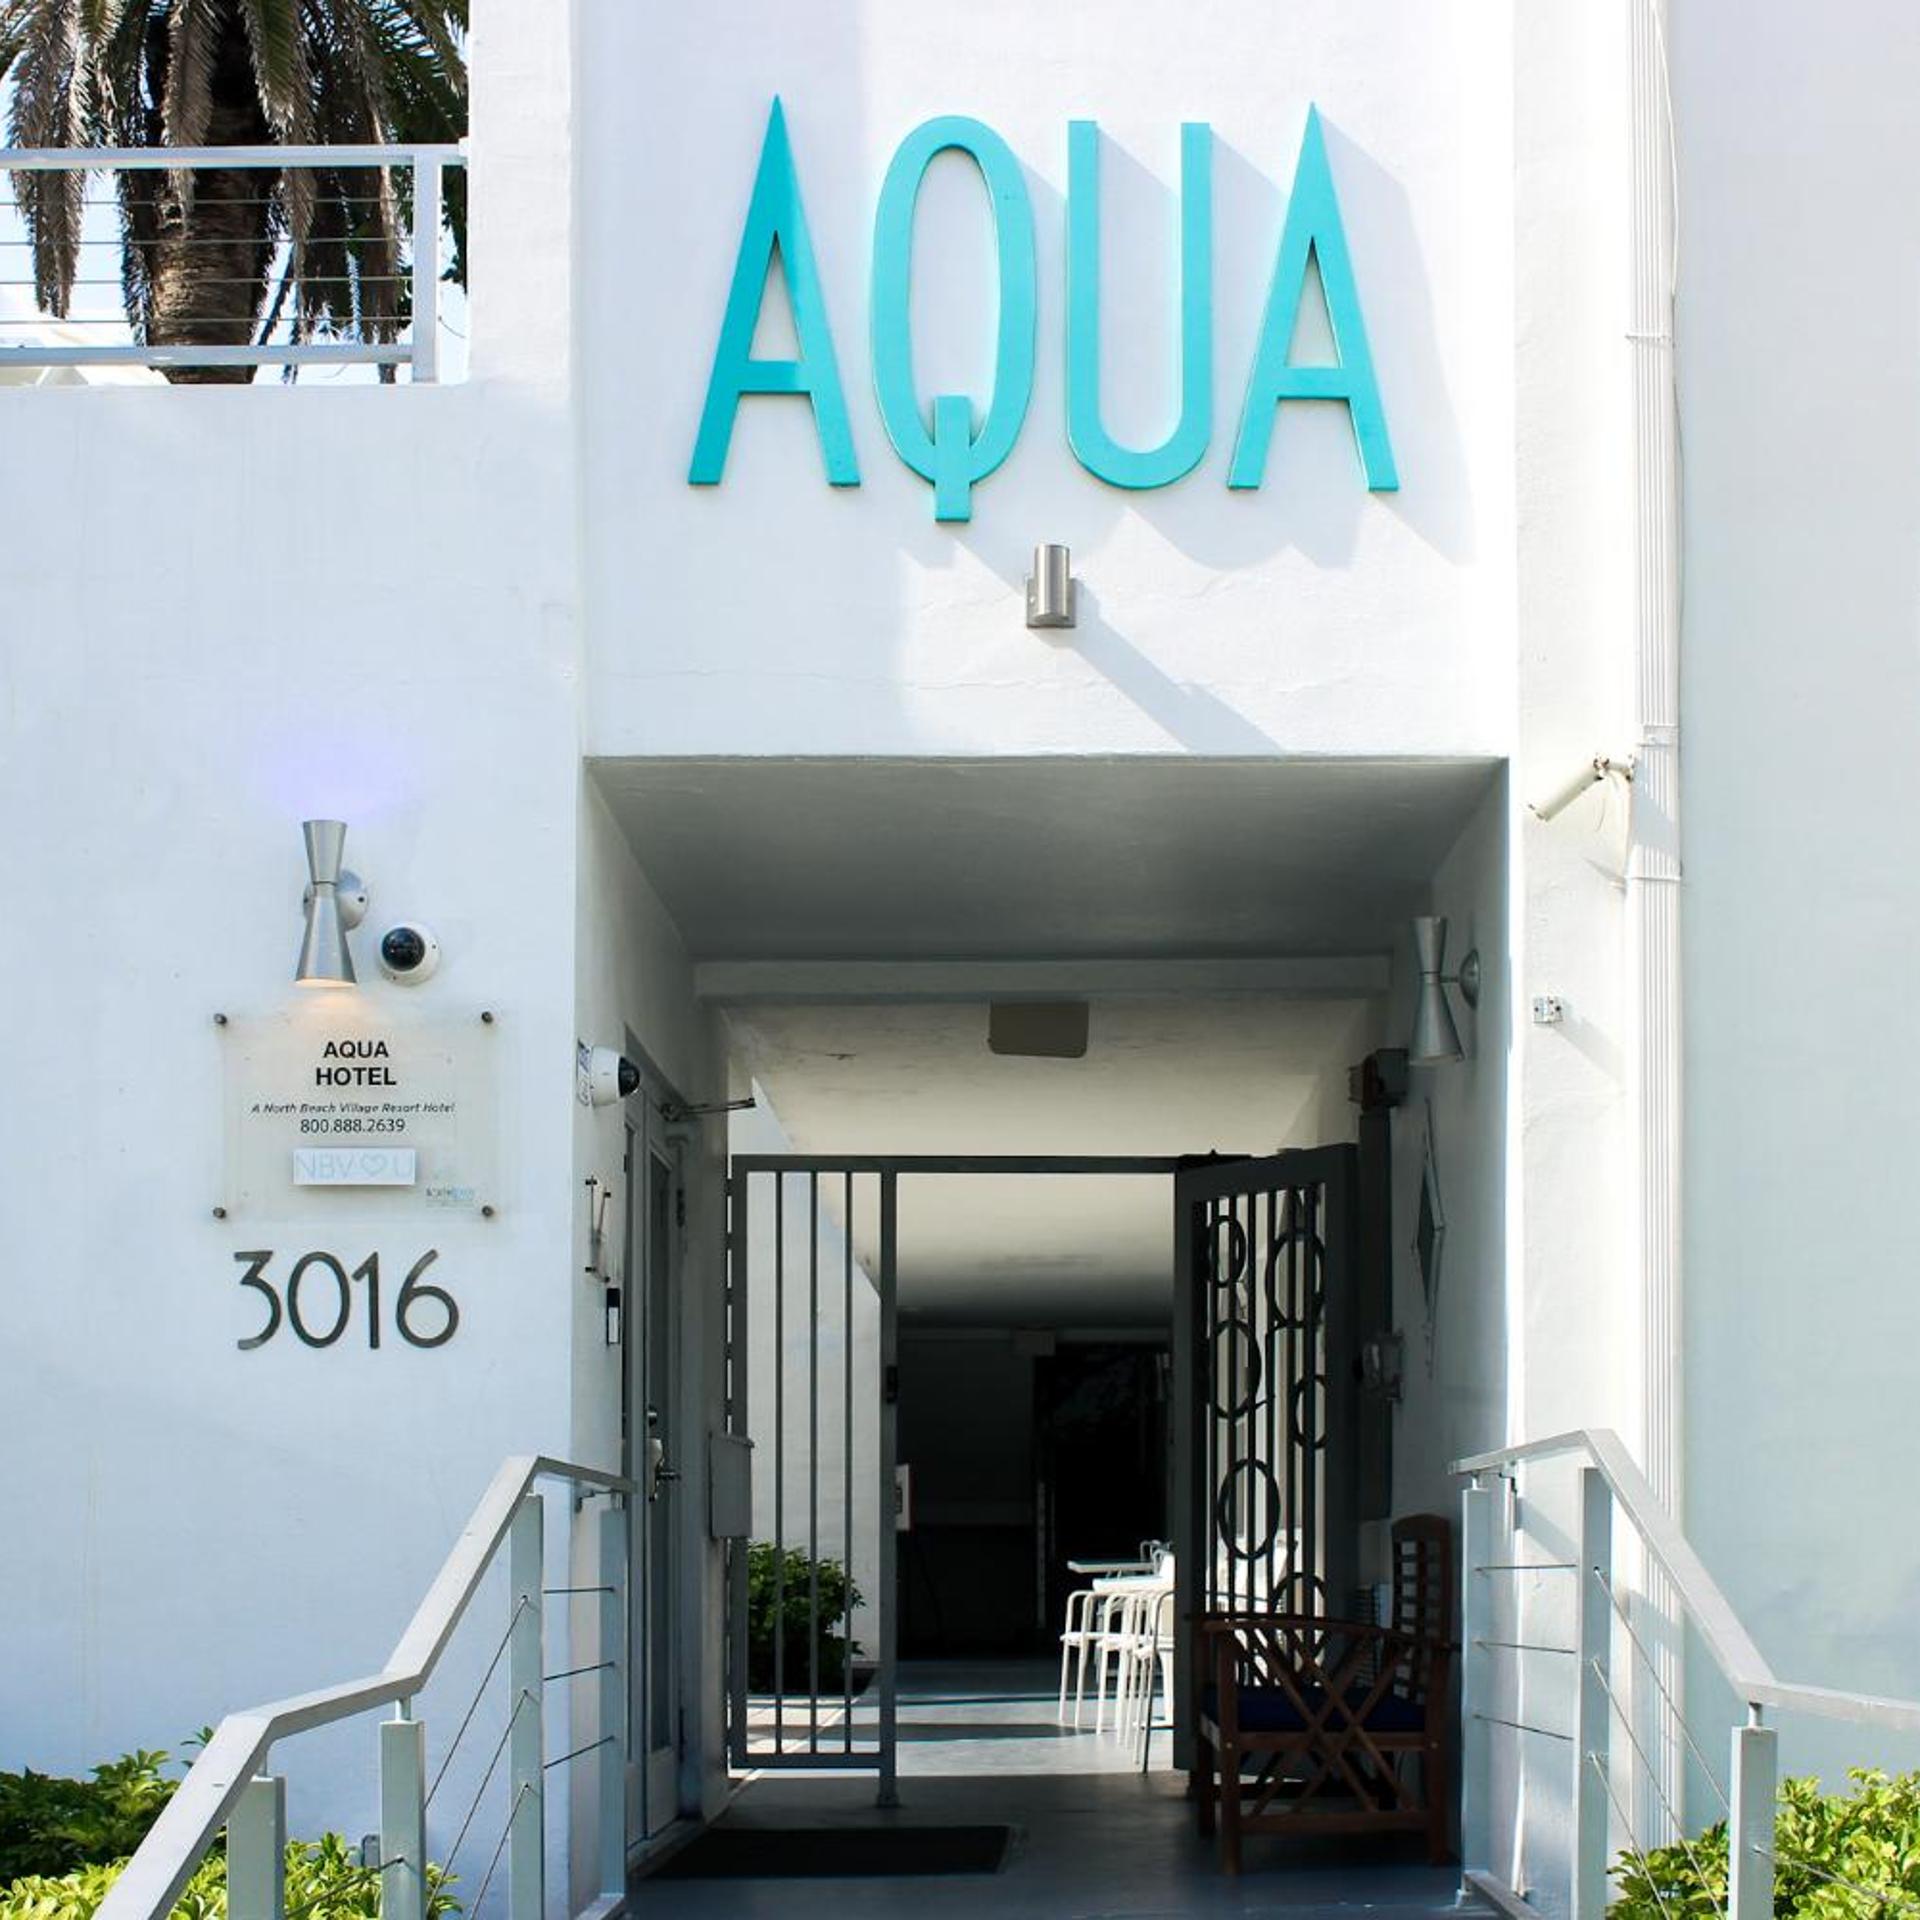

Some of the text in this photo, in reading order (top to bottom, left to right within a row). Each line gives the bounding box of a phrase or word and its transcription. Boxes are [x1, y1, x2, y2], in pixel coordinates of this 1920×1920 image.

[688, 94, 1400, 522] AQUA
[323, 1040, 389, 1059] AQUA
[316, 1067, 397, 1086] HOTEL
[251, 1102, 455, 1114] A North Beach Village Resort Hotel
[300, 1118, 406, 1134] 800.888.2639
[234, 1249, 459, 1350] 3016
